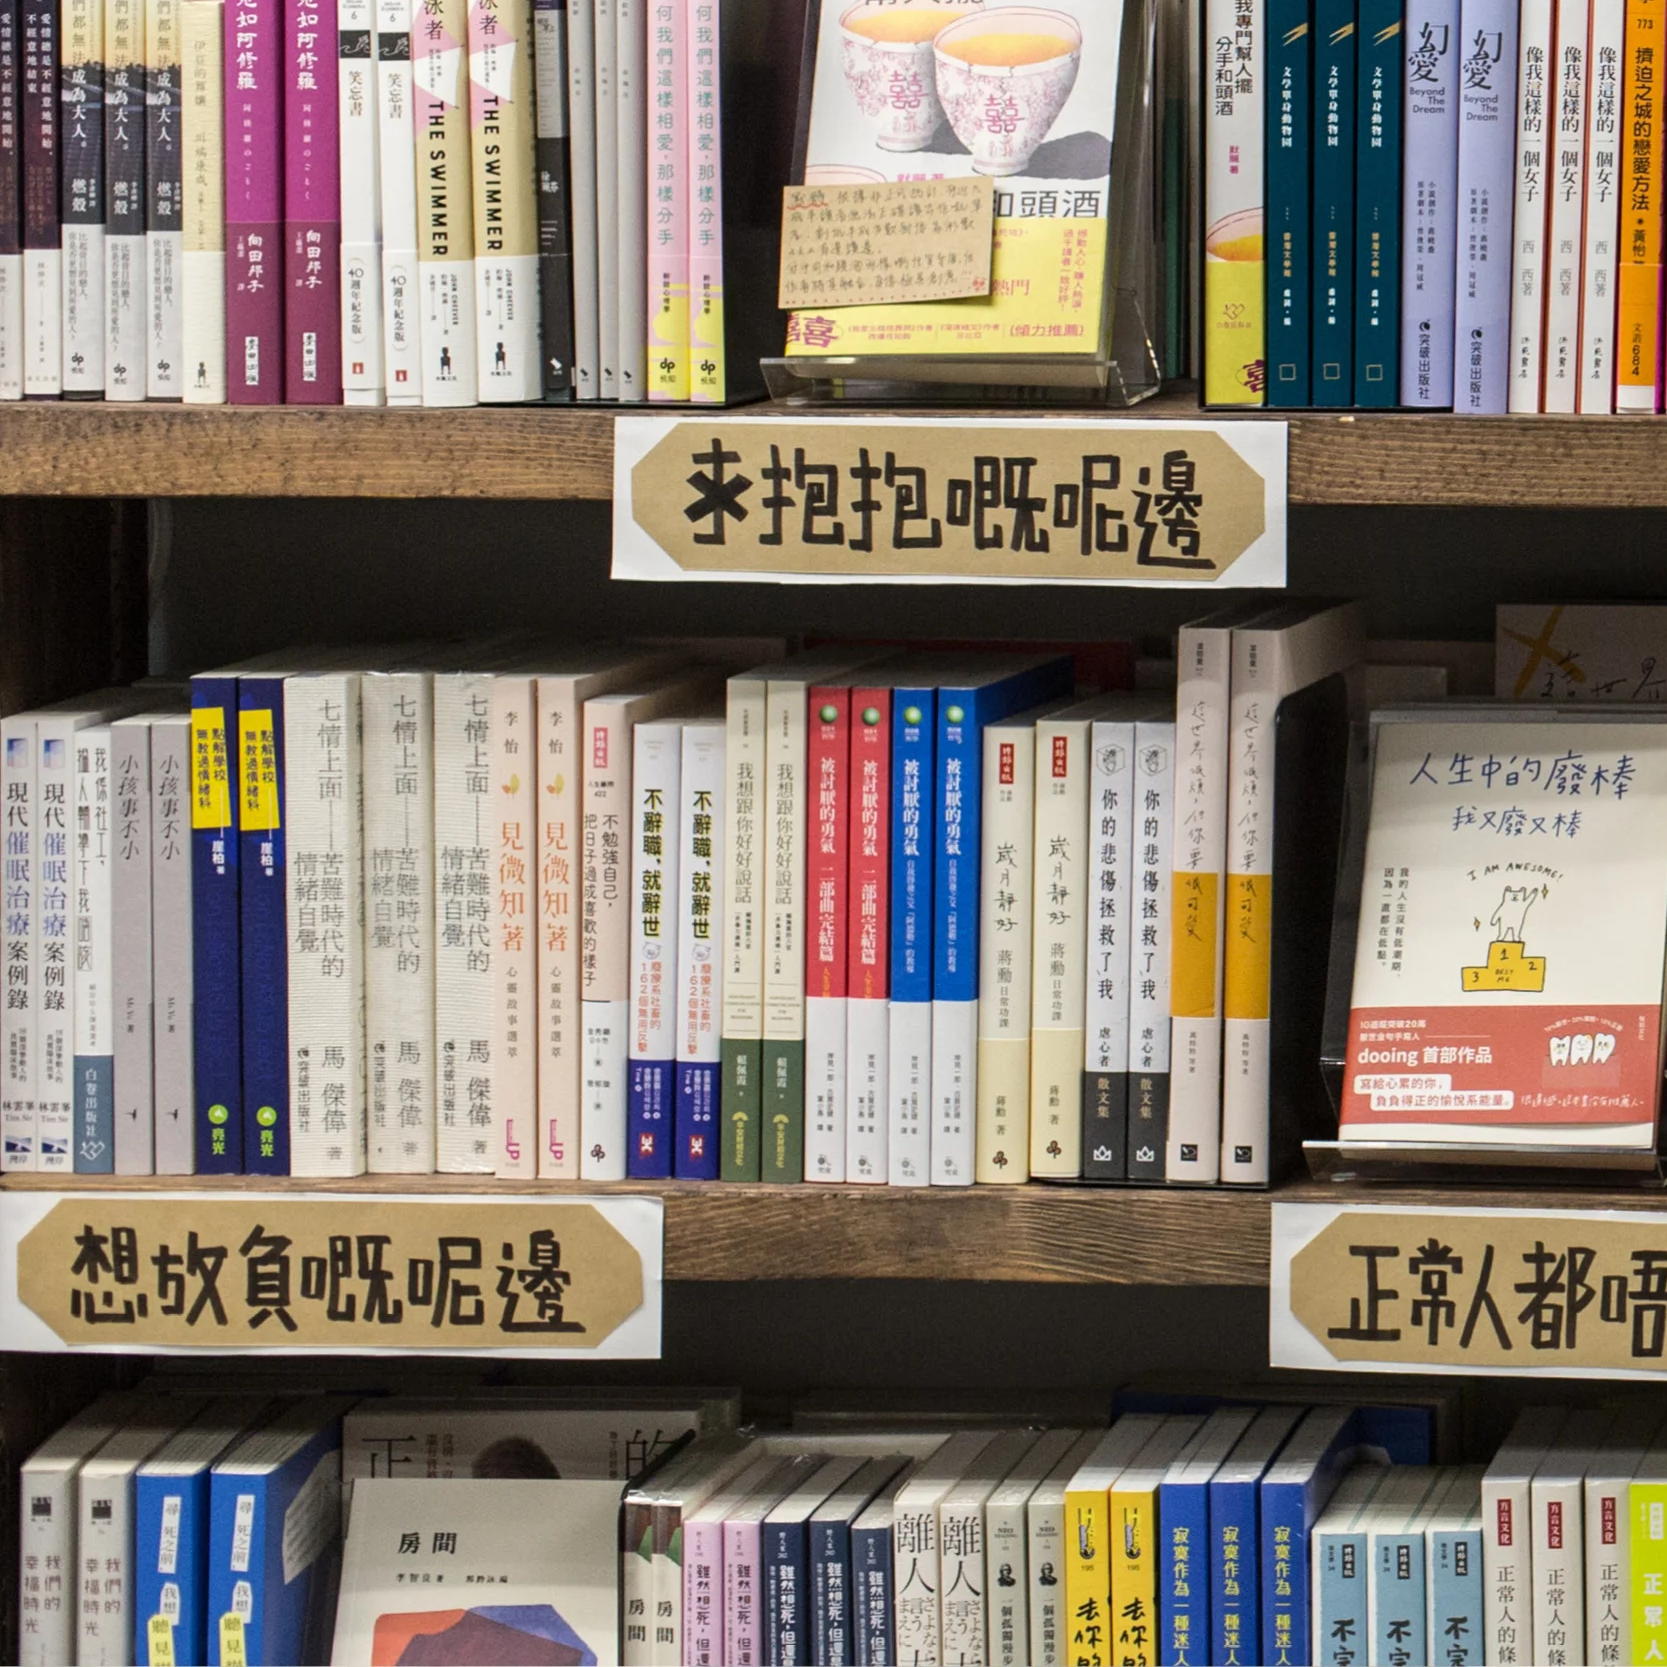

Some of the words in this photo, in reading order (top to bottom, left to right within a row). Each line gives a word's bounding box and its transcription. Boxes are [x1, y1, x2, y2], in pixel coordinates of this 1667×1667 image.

[1215, 37, 1234, 117] 分手和頭酒
[1408, 22, 1448, 84] 幻愛
[1462, 30, 1502, 91] 幻愛
[348, 71, 363, 119] 笑忘書
[430, 101, 445, 142] THE
[483, 97, 498, 136] THE
[1521, 47, 1543, 202] 像我這樣的一個女子
[1631, 47, 1652, 212] 擠迫之城的戀愛方法
[430, 148, 448, 257] SWIMMER
[483, 142, 501, 252] SWIMMER
[1410, 750, 1636, 800] 人生中的廢棒
[1453, 806, 1583, 840] 我又廢又棒
[6, 782, 29, 1010] 現代催眠治療案例錄
[1099, 788, 1118, 1001] 你的悲傷拯救了我
[1142, 788, 1160, 1001] 你的悲傷拯救了我
[1484, 866, 1499, 877] AM
[1359, 1047, 1417, 1066] dooing
[1423, 1047, 1493, 1065] 首部作品
[71, 1225, 586, 1333] 想放負嘅呢邊
[398, 1532, 458, 1556] 房間
[898, 1515, 936, 1596] 離人
[944, 1515, 981, 1596] 離人
